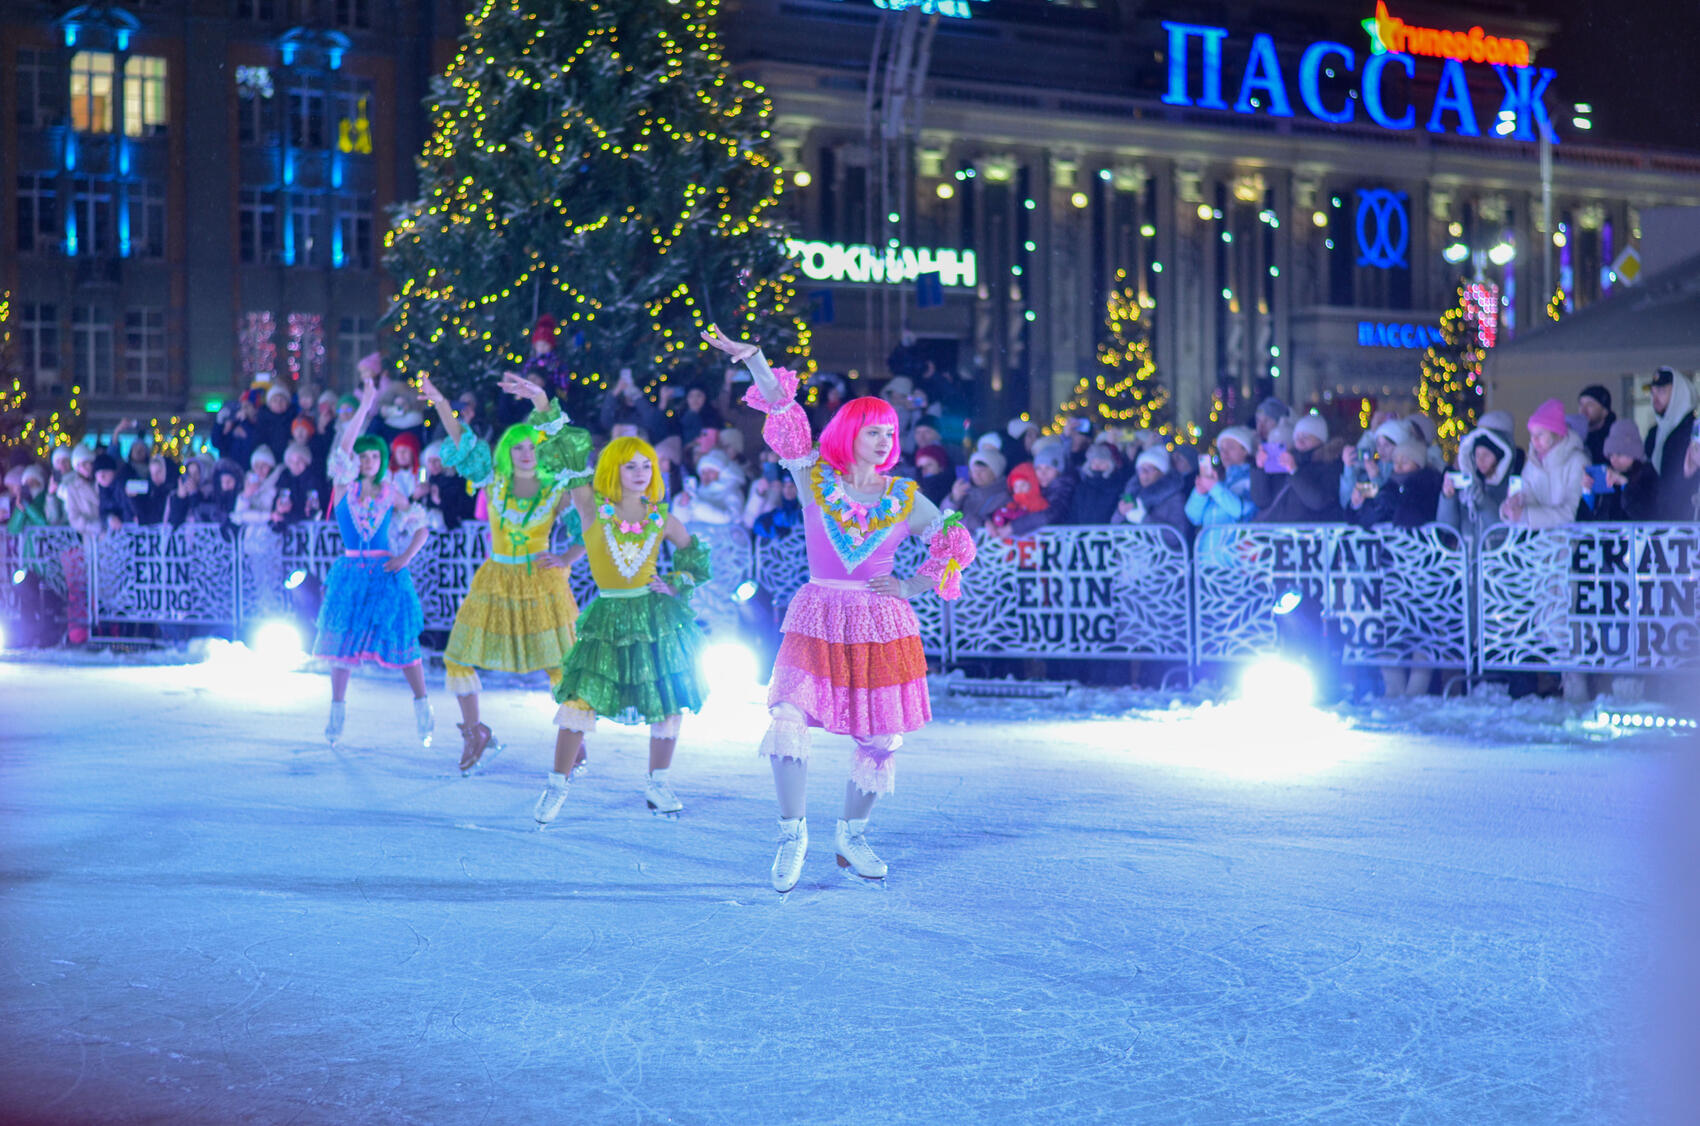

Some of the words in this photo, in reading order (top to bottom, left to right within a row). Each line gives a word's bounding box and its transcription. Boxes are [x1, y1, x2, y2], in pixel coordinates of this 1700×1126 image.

[1162, 20, 1560, 144] ПАССАЖ
[785, 239, 976, 286] ТОКМАНН
[439, 533, 487, 558] ERA
[1018, 540, 1112, 570] ERAT
[1272, 538, 1381, 572] ERAT
[1569, 538, 1698, 574] ERAT
[135, 562, 190, 584] ERIN
[136, 589, 191, 611] BURG
[1018, 577, 1112, 608] ERIN
[1569, 580, 1697, 616] ERIN
[1020, 613, 1117, 643] BURG
[1569, 622, 1700, 657] BURG
